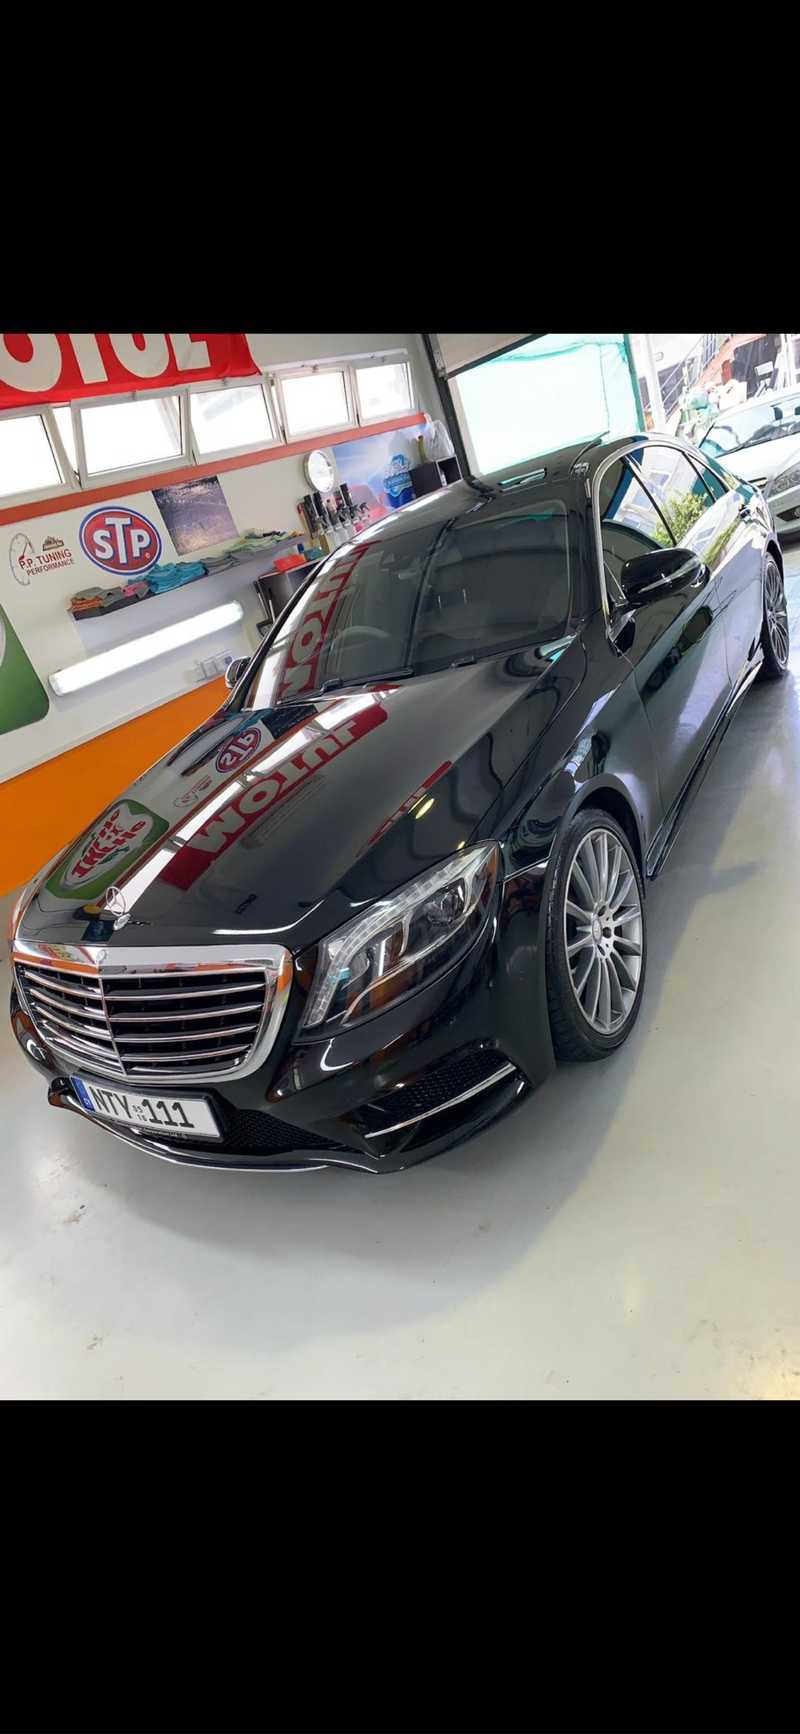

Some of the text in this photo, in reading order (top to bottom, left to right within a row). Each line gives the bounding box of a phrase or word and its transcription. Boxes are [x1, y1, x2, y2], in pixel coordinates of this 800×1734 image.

[92, 517, 151, 564] STP
[27, 558, 74, 577] PERFORMANCE
[37, 549, 73, 564] TUNING
[89, 1086, 195, 1128] NTY 111
